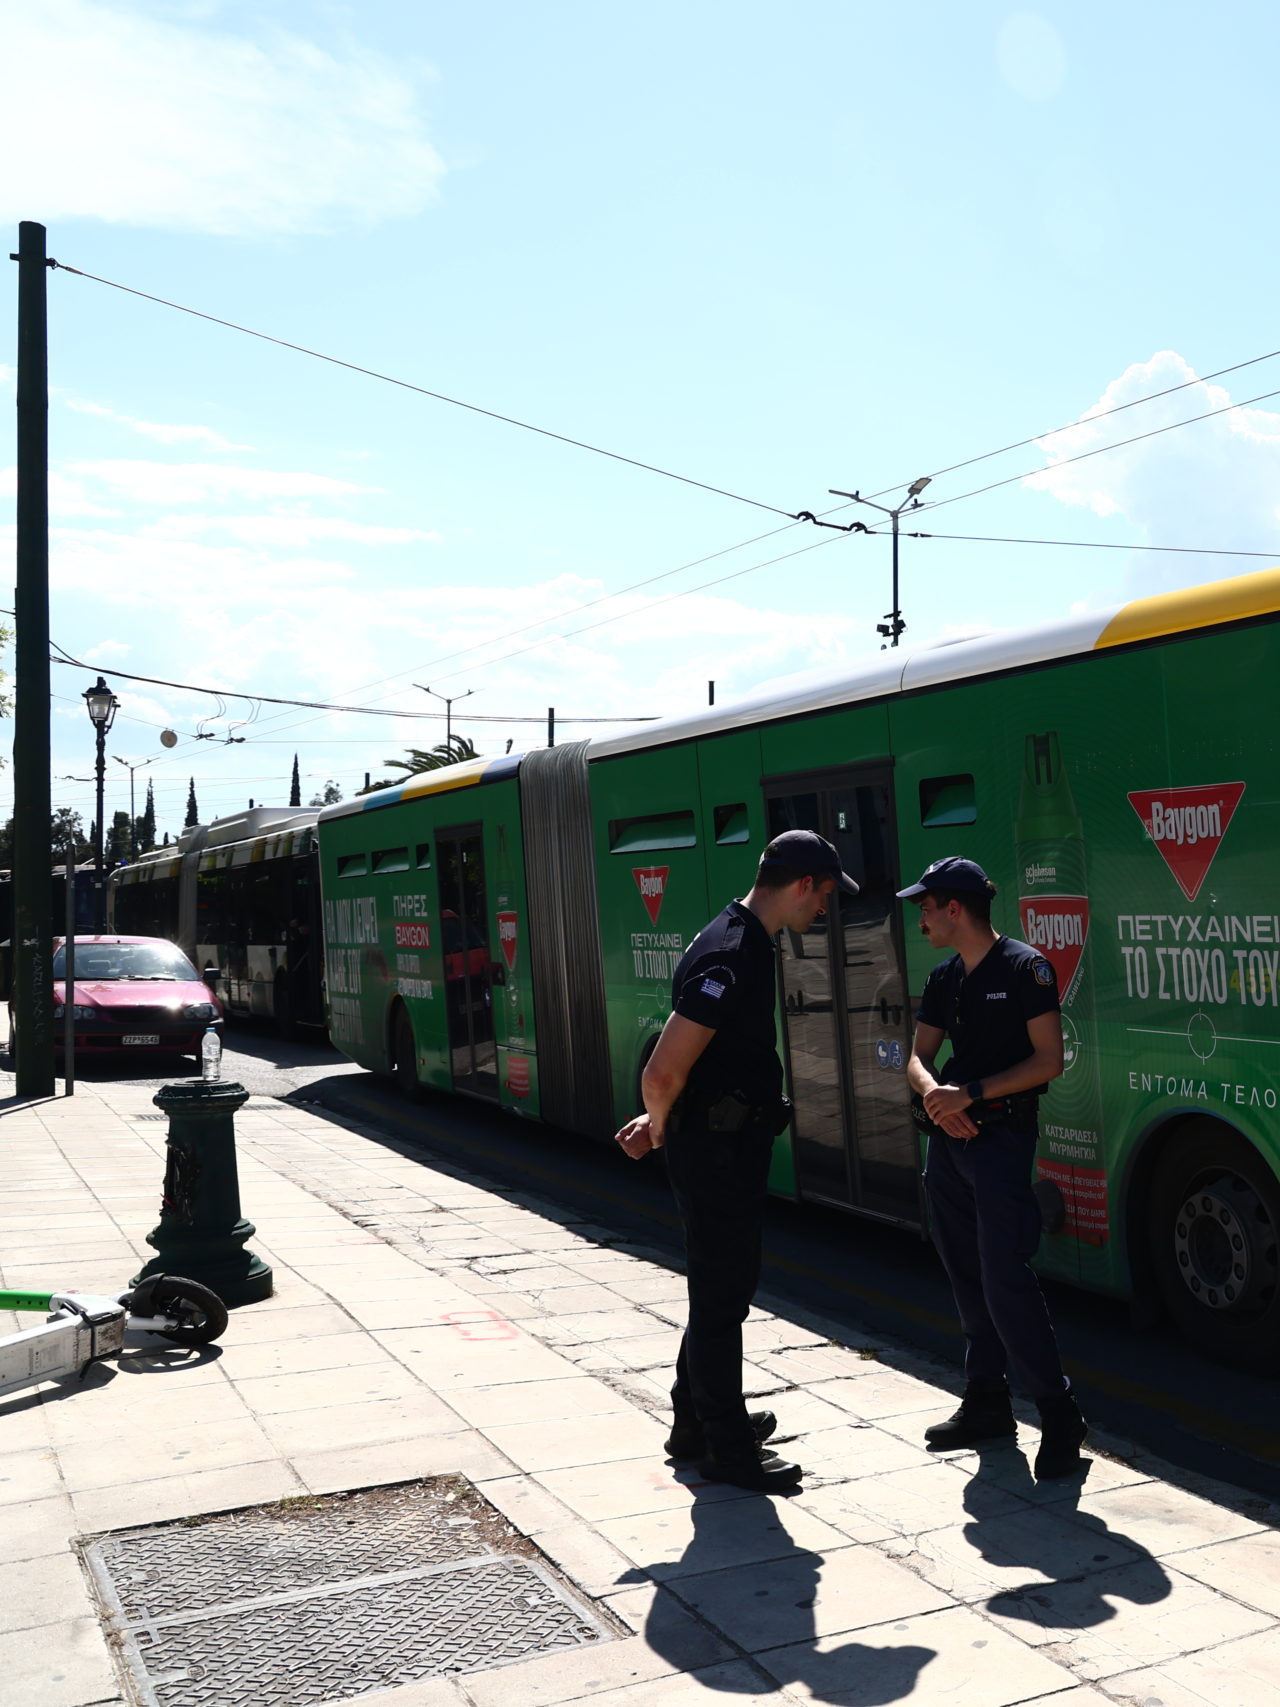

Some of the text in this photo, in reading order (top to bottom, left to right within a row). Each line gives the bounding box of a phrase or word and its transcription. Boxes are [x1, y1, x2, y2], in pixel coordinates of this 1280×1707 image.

[1151, 801, 1222, 846] Baygon
[639, 874, 663, 897] Baygon
[393, 894, 428, 918] ΠΗΡΕΣ
[395, 926, 430, 947] BAYGON
[630, 932, 682, 949] ΠΕΤΥΧΑΙΝΕΙ
[1026, 907, 1084, 951] Baygon
[1117, 915, 1280, 943] ΠΕΤΥΧΑΙΝΕΙ
[632, 950, 644, 978] ΤΟ
[645, 950, 669, 980] ΣΤΟΧΟ
[1121, 946, 1280, 1007] ΤΟ ΣΤΟΧΟ ΤΟΥ
[985, 992, 1007, 1001] POLICE
[1128, 1072, 1209, 1100] ΕΝΤΟΜΑ
[1045, 1123, 1092, 1144] ΚΑΤΣΑΡΙΔΕΣ
[1049, 1141, 1097, 1161] ΜΥΡΜΗΓΚΙΑ
